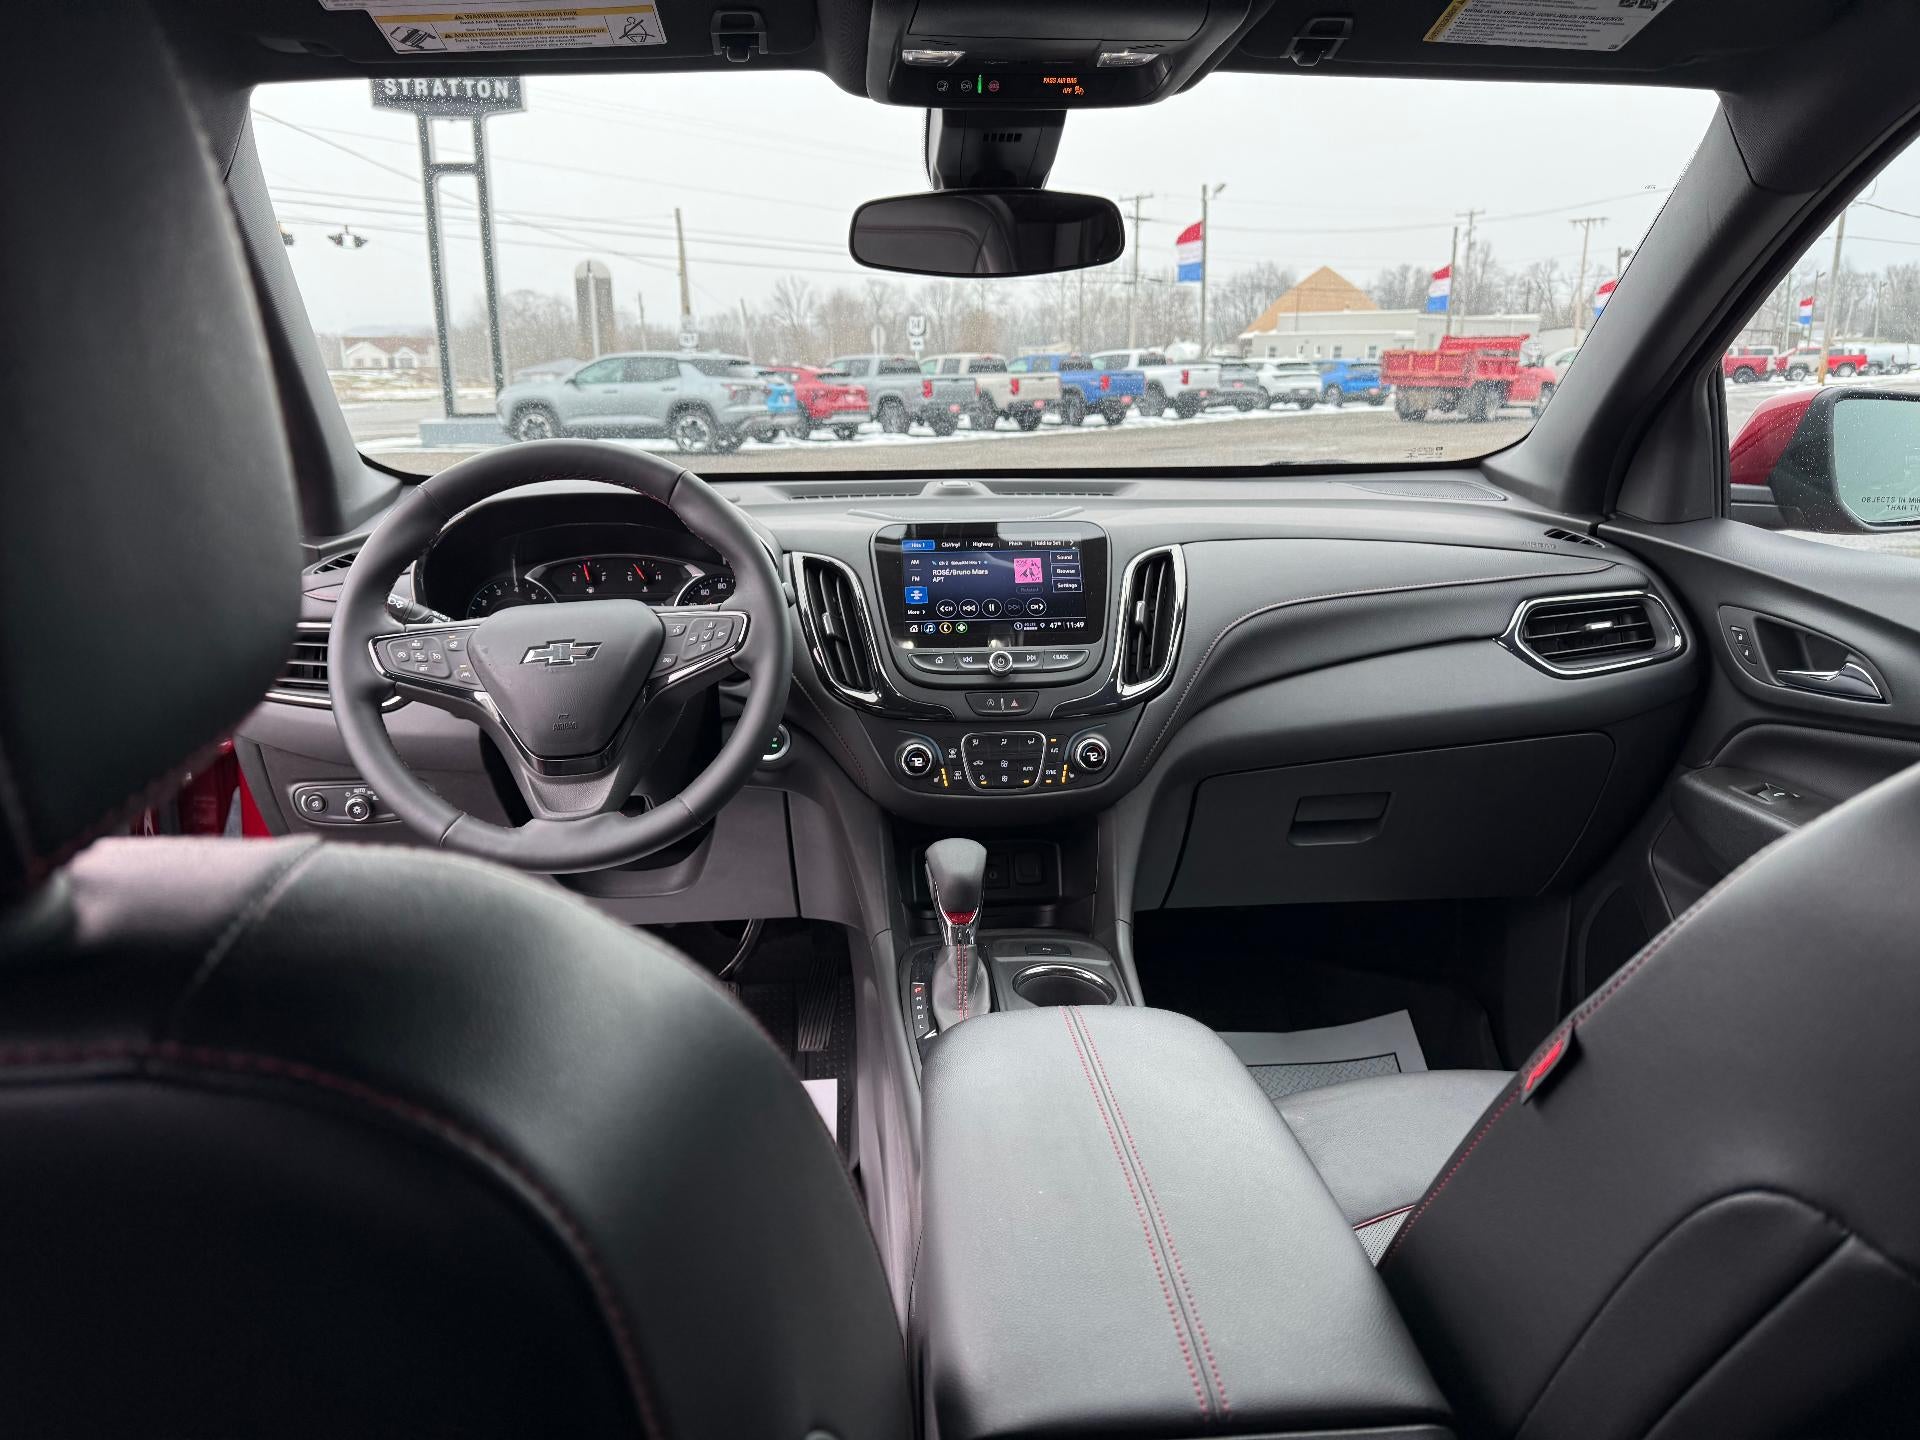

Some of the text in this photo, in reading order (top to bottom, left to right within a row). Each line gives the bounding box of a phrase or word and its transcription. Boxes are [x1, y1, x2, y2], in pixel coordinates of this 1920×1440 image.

[383, 78, 510, 99] STRATTON
[1066, 621, 1085, 629] 11:49
[1086, 752, 1098, 762] 72
